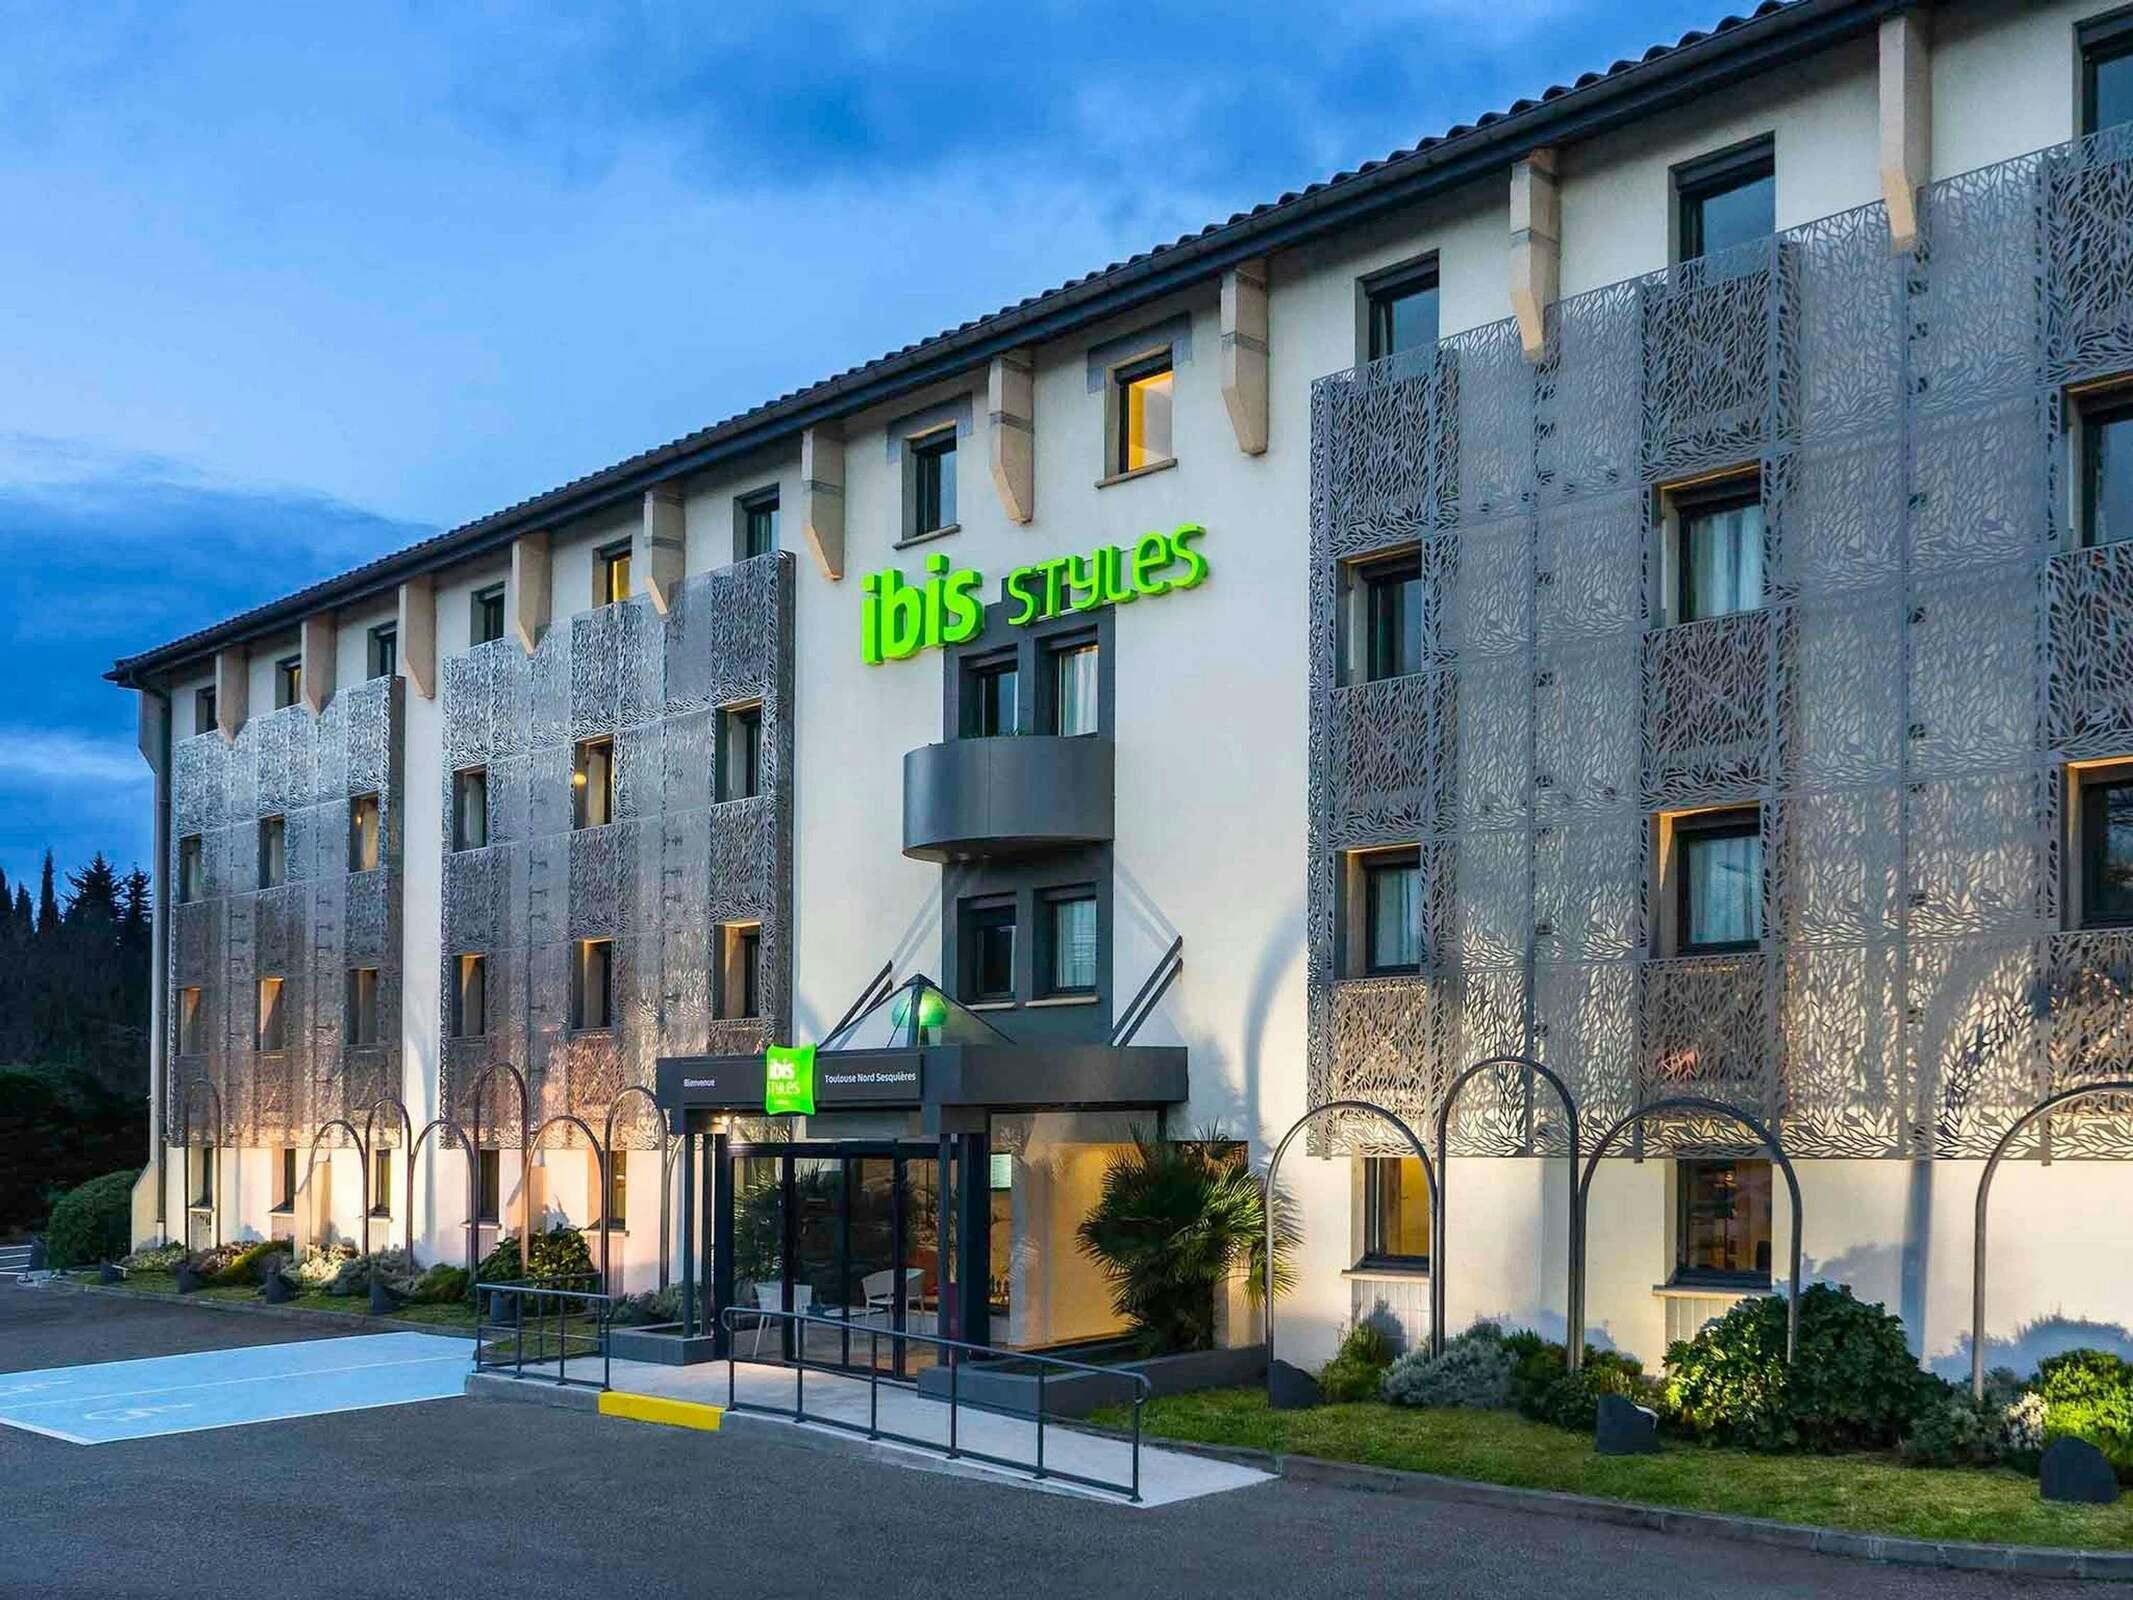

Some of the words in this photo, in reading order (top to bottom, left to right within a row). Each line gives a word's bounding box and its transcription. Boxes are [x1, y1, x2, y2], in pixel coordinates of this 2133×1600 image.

[862, 554, 985, 665] ibis
[769, 1058, 795, 1080] ibis
[683, 1078, 716, 1088] Bienvenue
[825, 1074, 857, 1084] Toulouse
[857, 1073, 875, 1082] Nord
